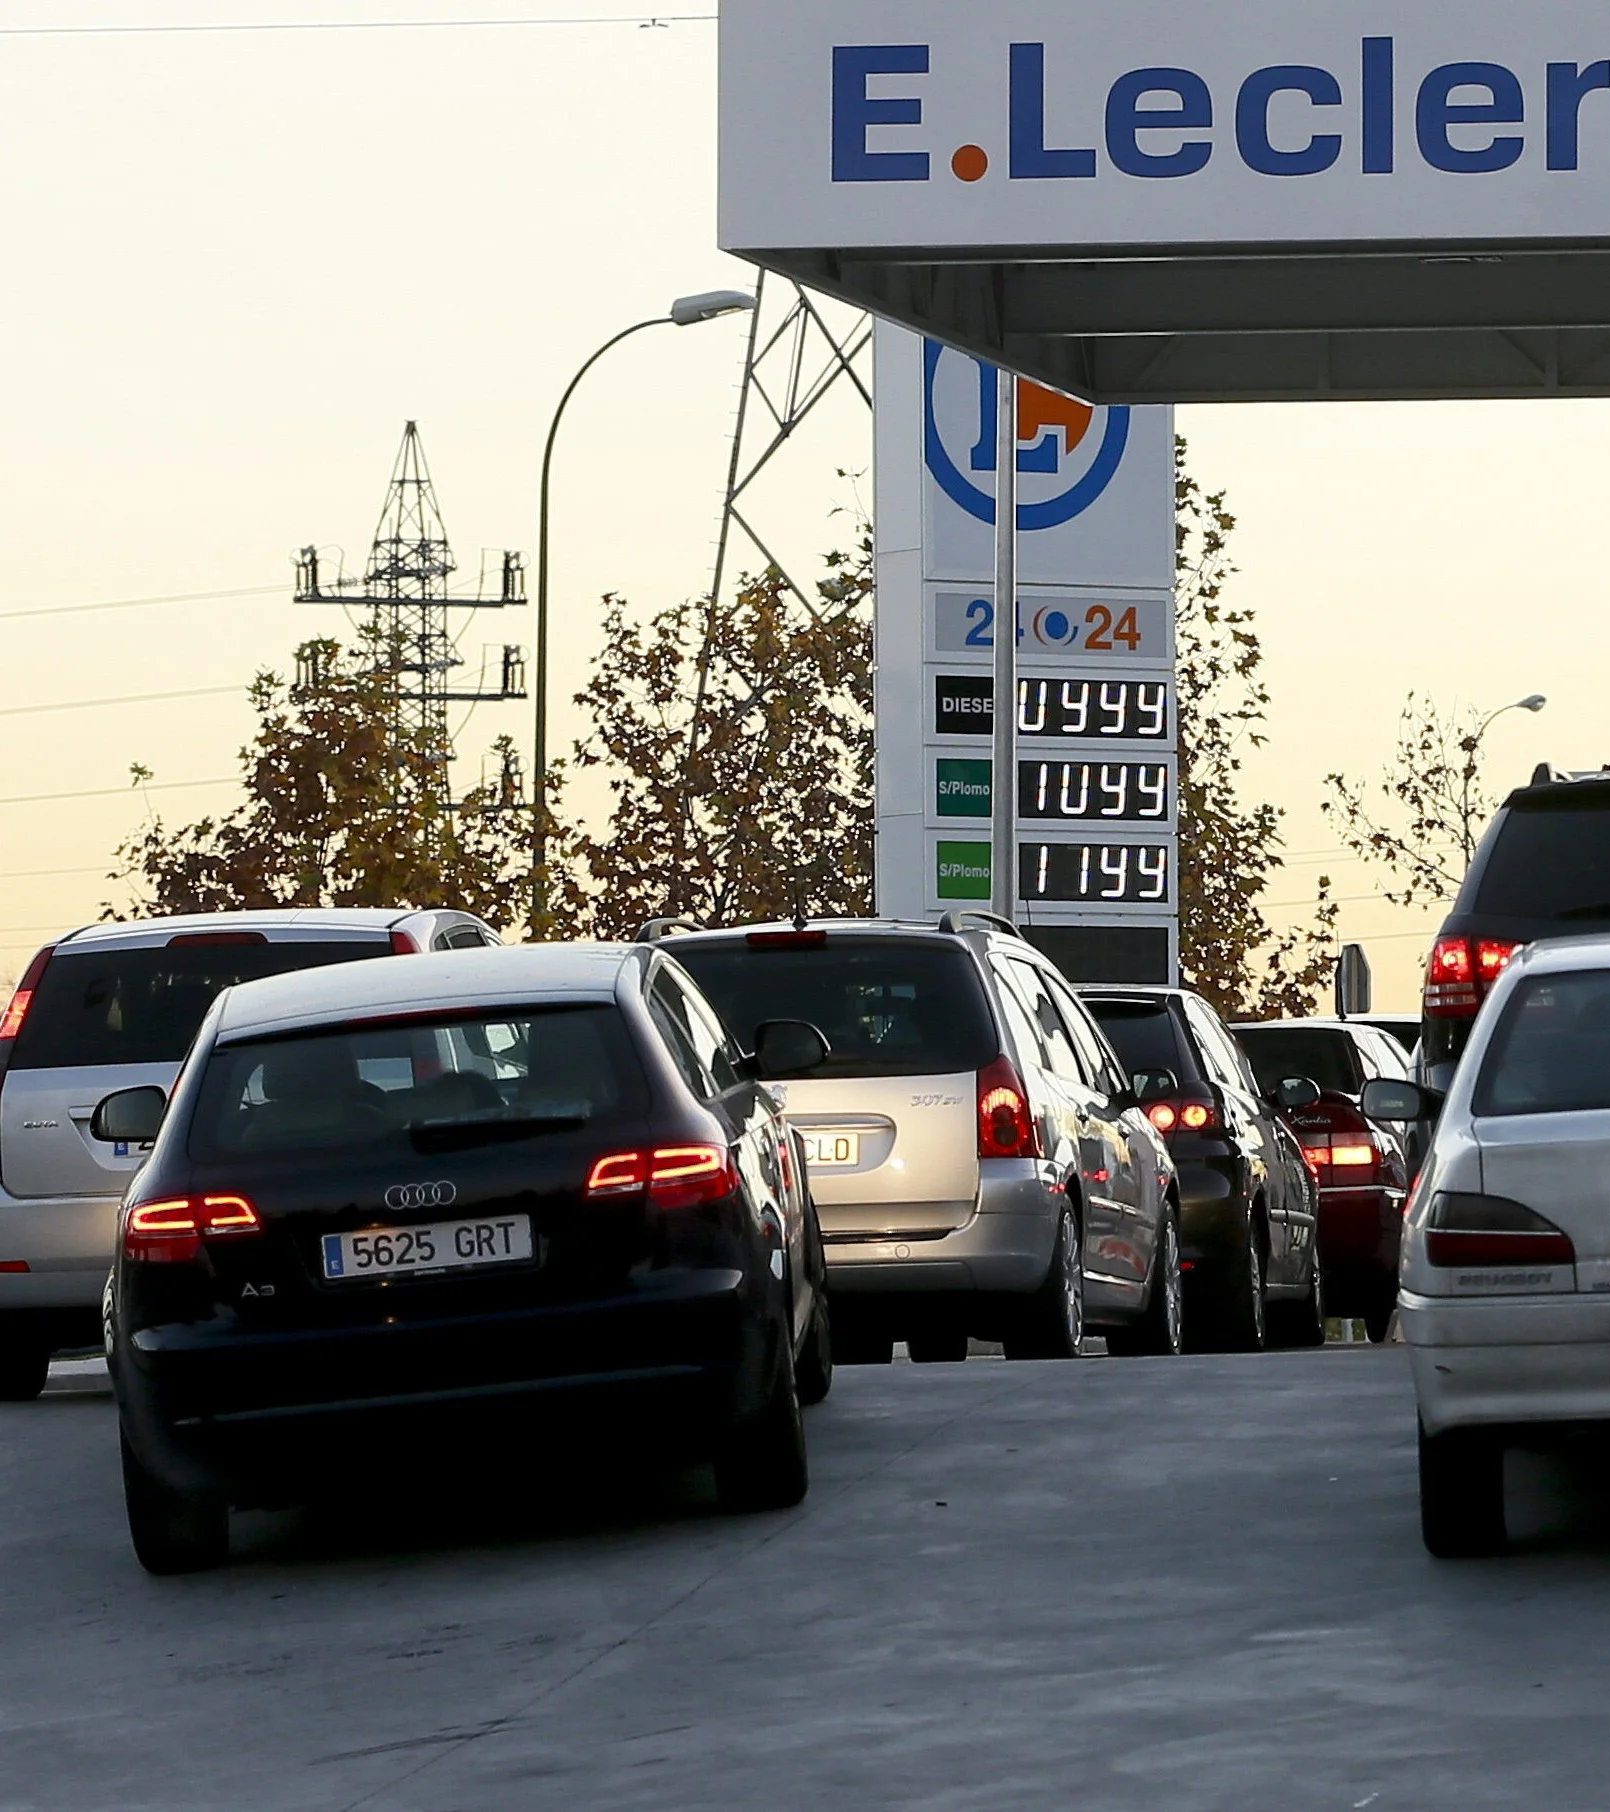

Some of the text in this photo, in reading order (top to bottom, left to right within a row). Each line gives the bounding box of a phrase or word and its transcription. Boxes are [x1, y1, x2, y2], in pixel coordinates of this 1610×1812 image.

[1085, 604, 1141, 650] 24
[943, 697, 993, 714] DIESE
[939, 781, 990, 796] S/Plomo
[939, 863, 990, 878] S/Plomo
[805, 1138, 849, 1161] CLD
[352, 1232, 436, 1268] 5625
[455, 1222, 515, 1258] GRT
[241, 1282, 275, 1297] A3
